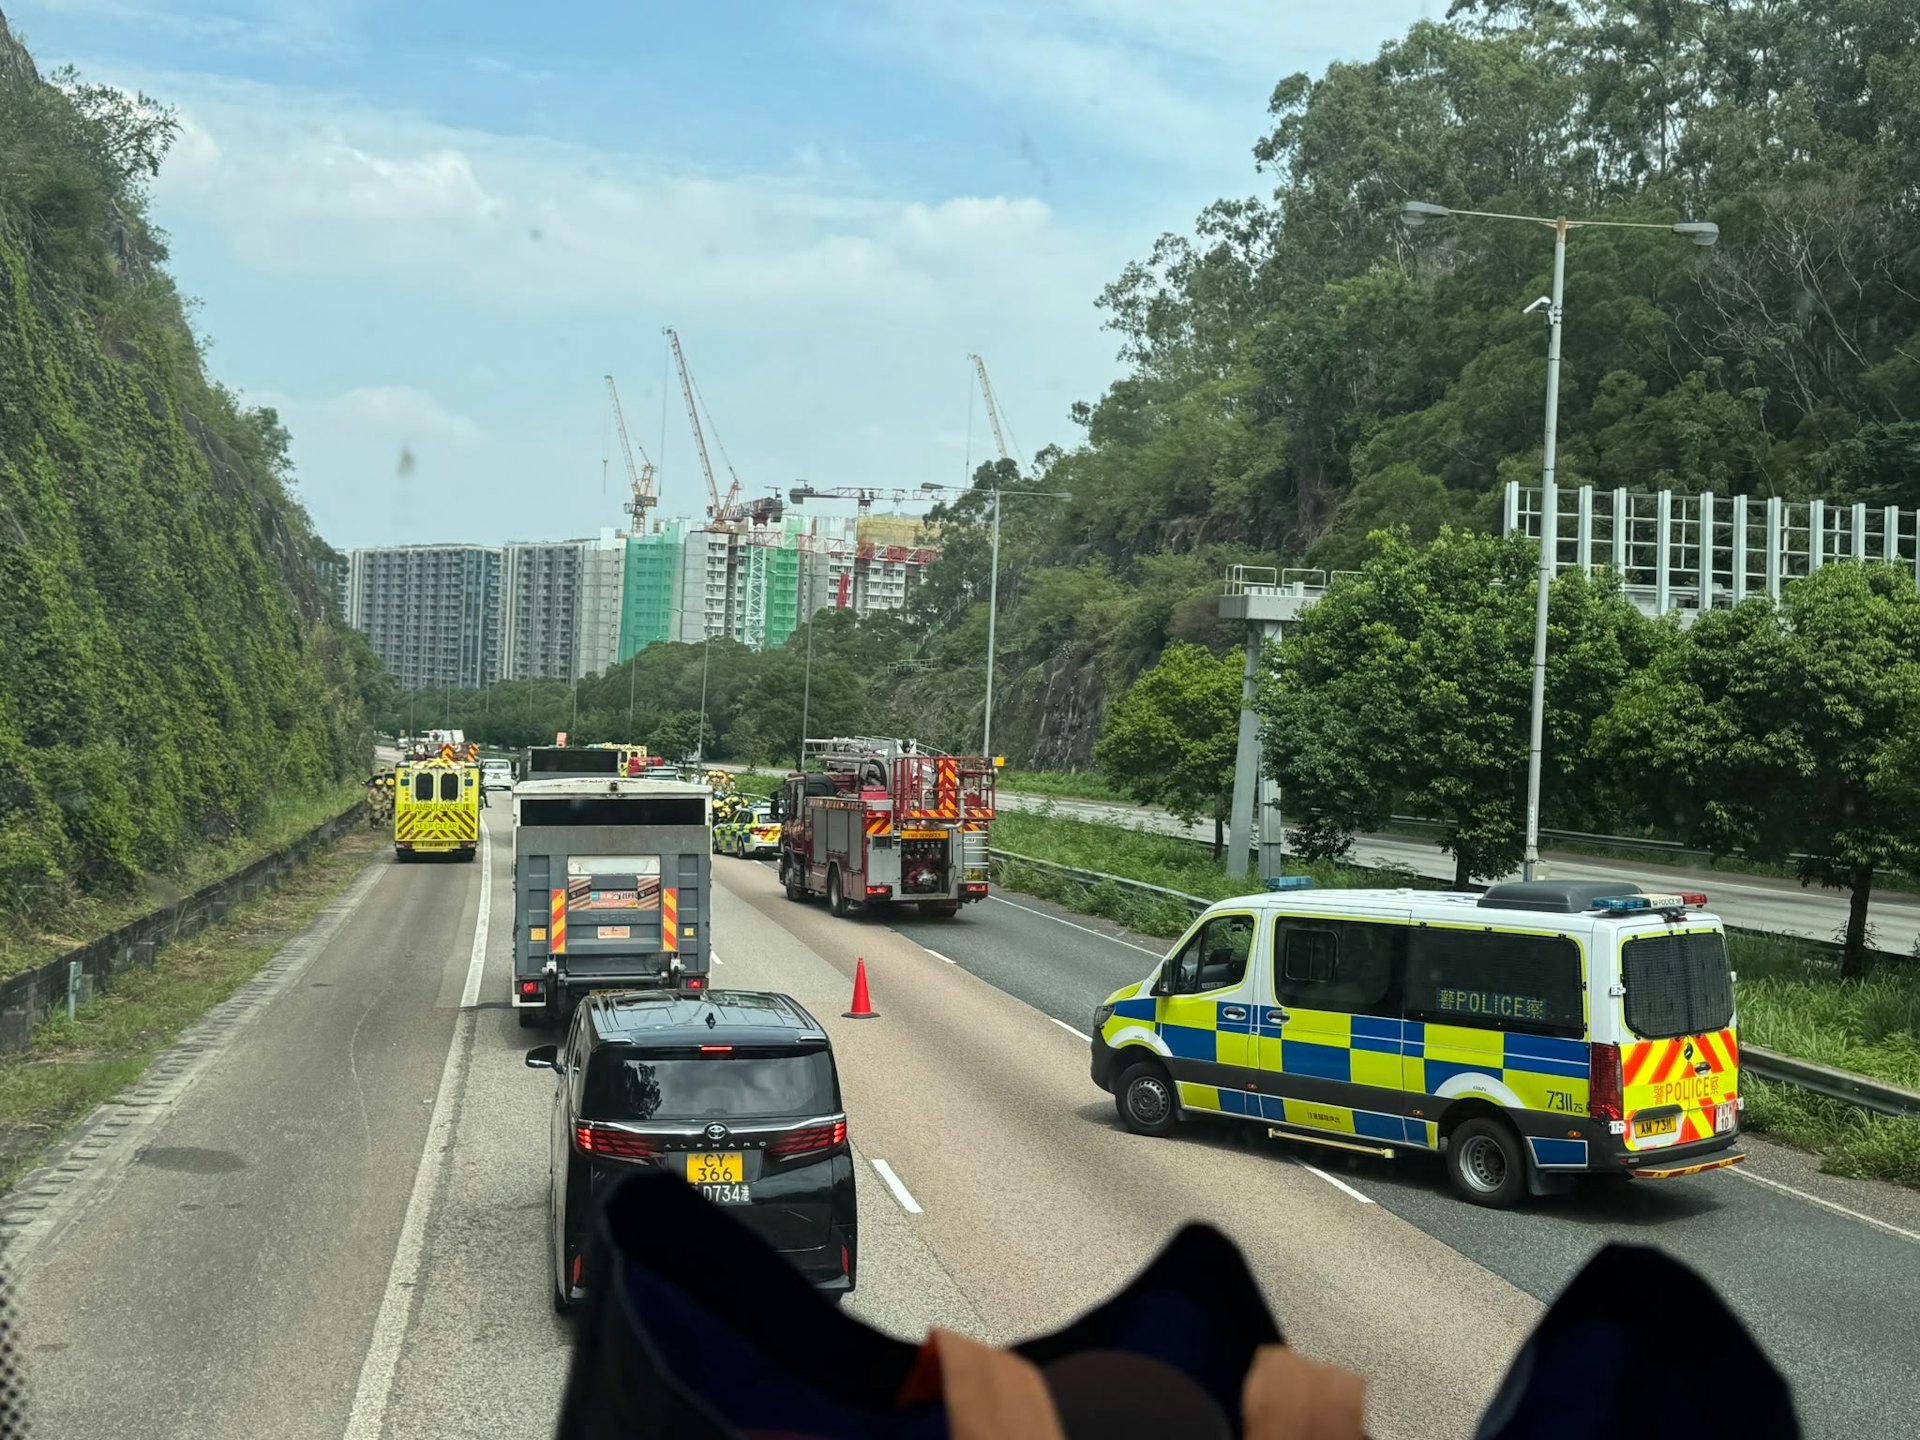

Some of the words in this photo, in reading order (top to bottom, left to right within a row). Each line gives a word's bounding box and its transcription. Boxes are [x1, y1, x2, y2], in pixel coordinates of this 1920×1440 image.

[415, 803, 460, 811] AMBULANCE
[435, 822, 458, 830] CLEAR
[1546, 1090, 1573, 1112] 7311
[1641, 1121, 1653, 1135] AM
[1655, 1117, 1672, 1133] 7311
[664, 1141, 767, 1149] ALPHARD
[704, 1153, 726, 1168] CY
[697, 1167, 733, 1182] 366
